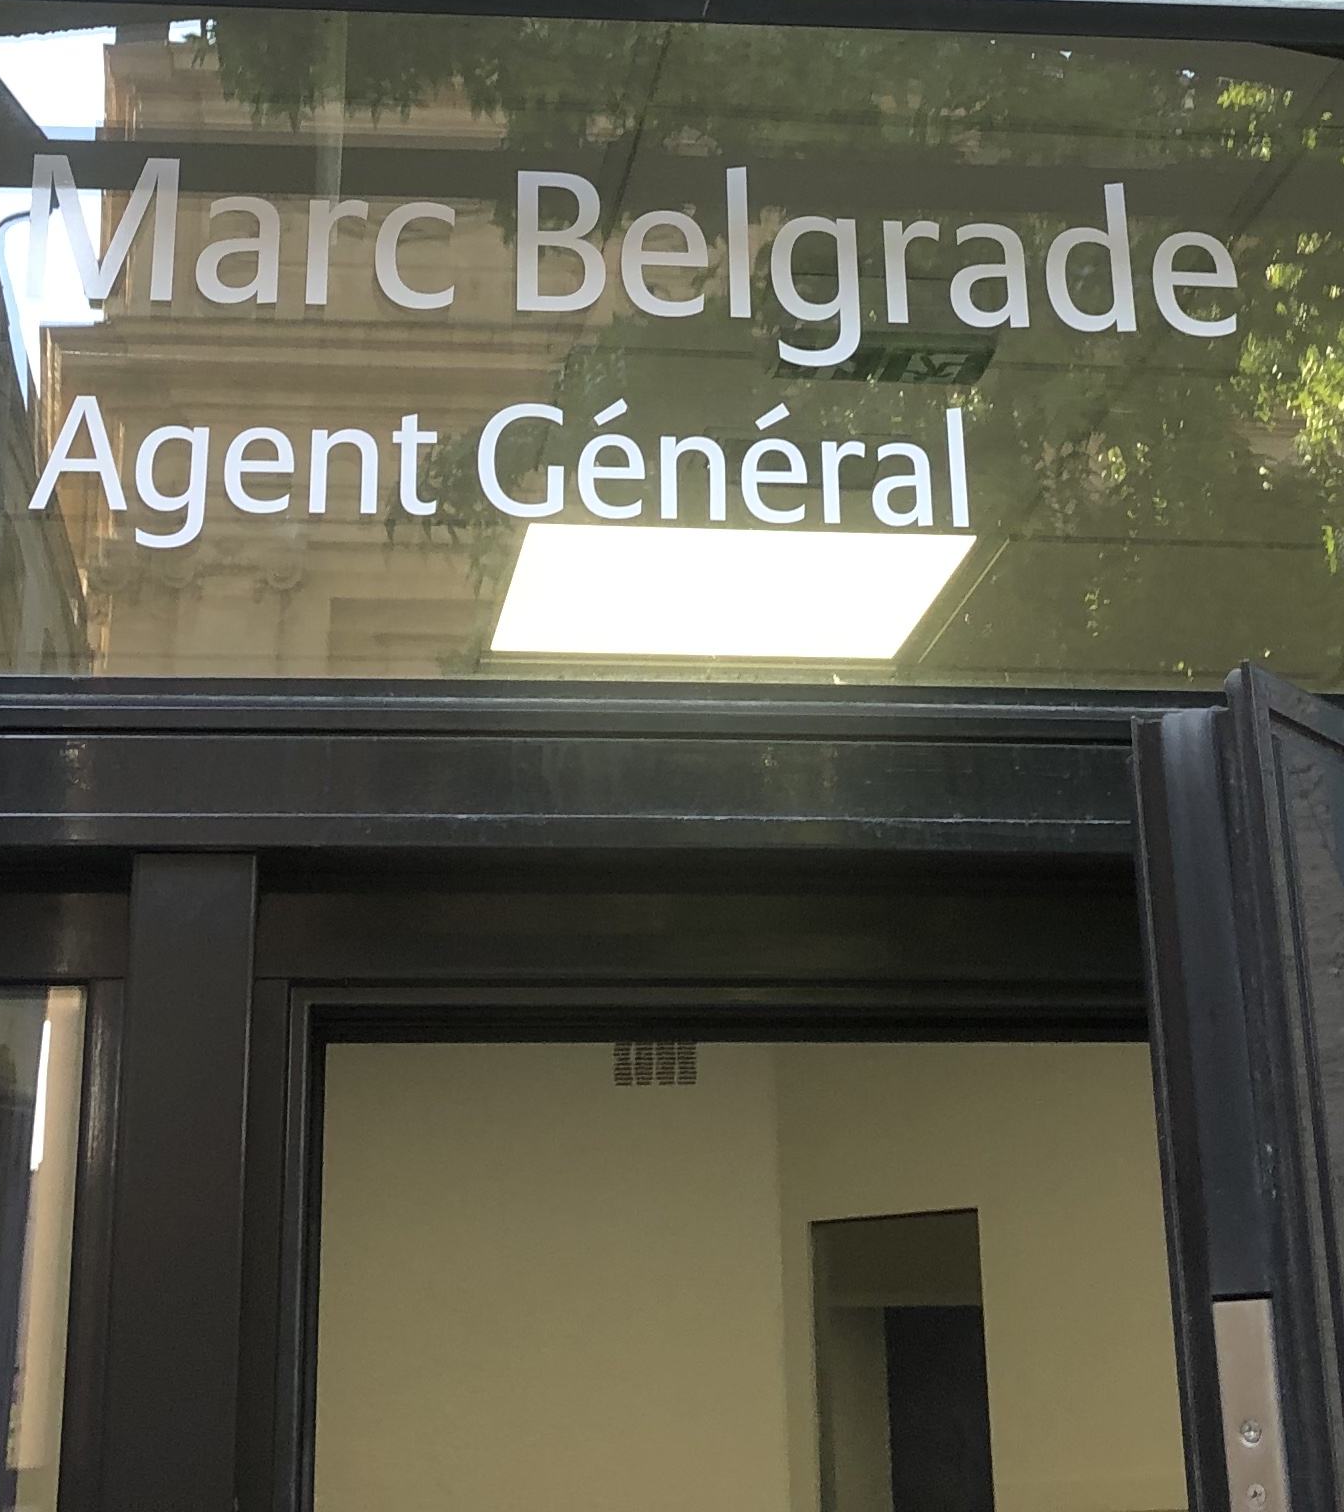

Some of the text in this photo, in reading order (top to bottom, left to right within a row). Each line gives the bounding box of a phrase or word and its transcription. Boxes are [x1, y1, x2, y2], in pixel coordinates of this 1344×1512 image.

[24, 153, 1240, 367] Marc Belgrade
[28, 394, 973, 549] Agent Général
